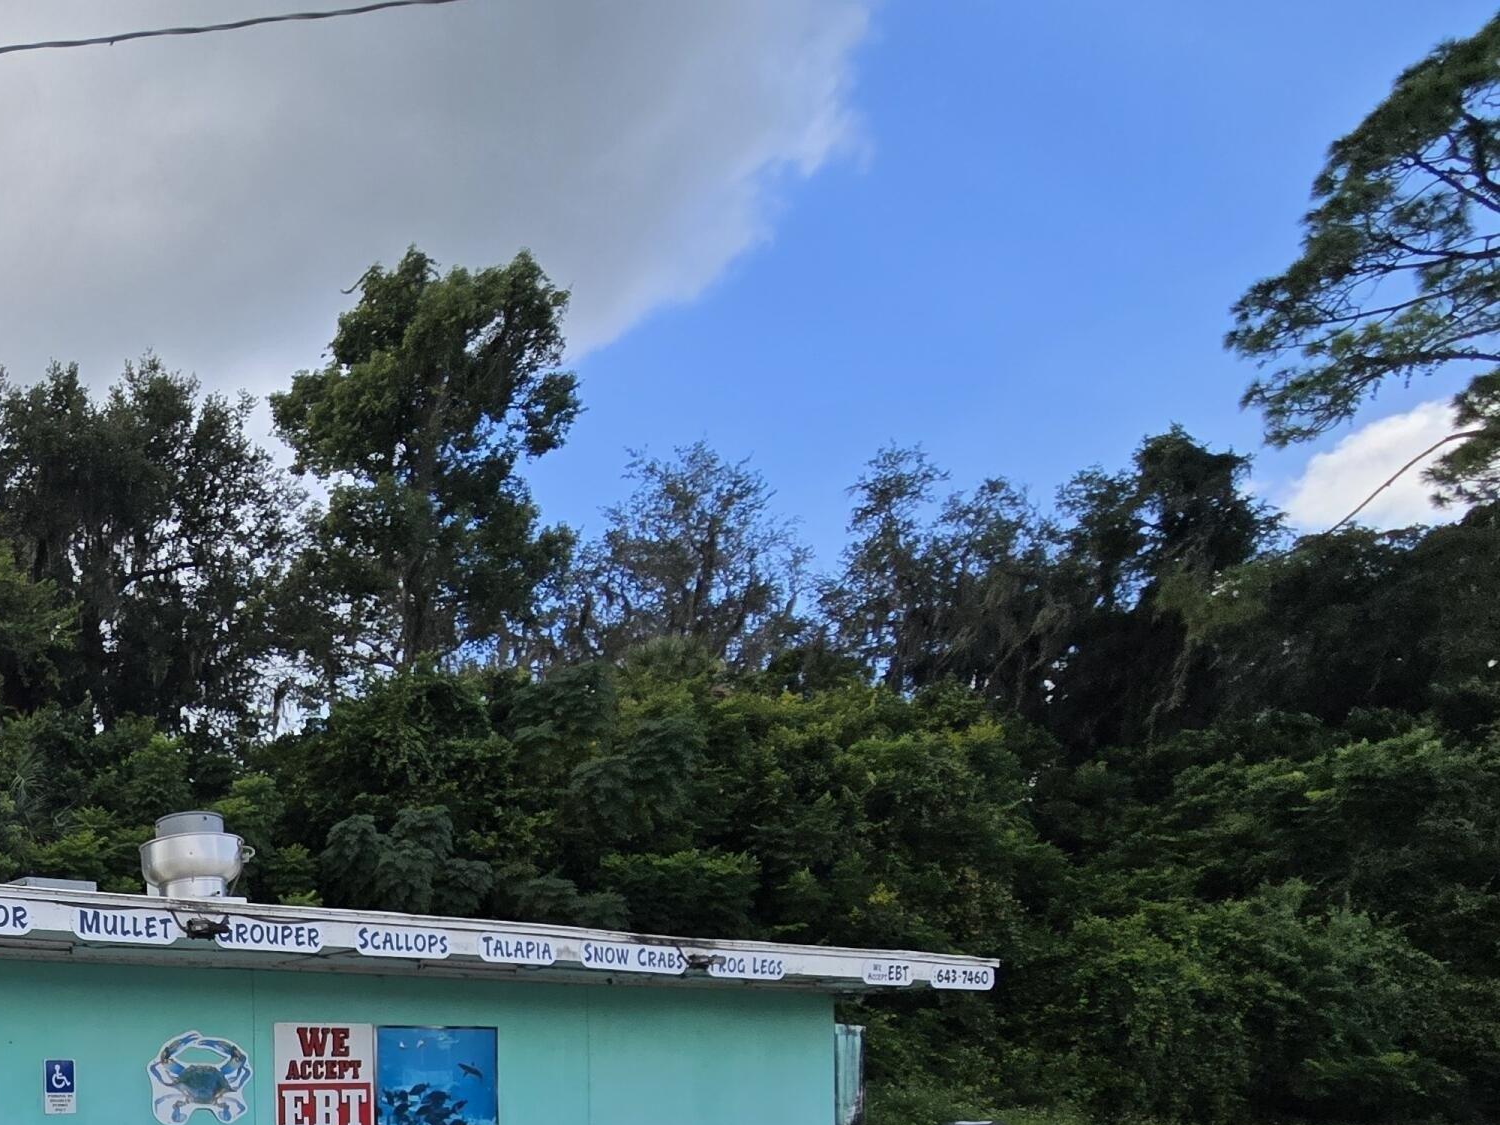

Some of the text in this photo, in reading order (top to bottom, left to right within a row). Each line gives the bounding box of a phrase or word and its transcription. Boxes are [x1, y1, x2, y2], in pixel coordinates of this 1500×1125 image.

[79, 910, 174, 940] MULLET
[358, 927, 448, 954] SCALLOPS
[482, 936, 552, 961] TALAPIA
[584, 942, 684, 970] SNOW CRABS
[752, 957, 783, 976] LEGS
[888, 965, 909, 981] EBT
[936, 969, 989, 984] 643-7460
[296, 1027, 349, 1057] WE
[285, 1060, 362, 1080] ACCEPT
